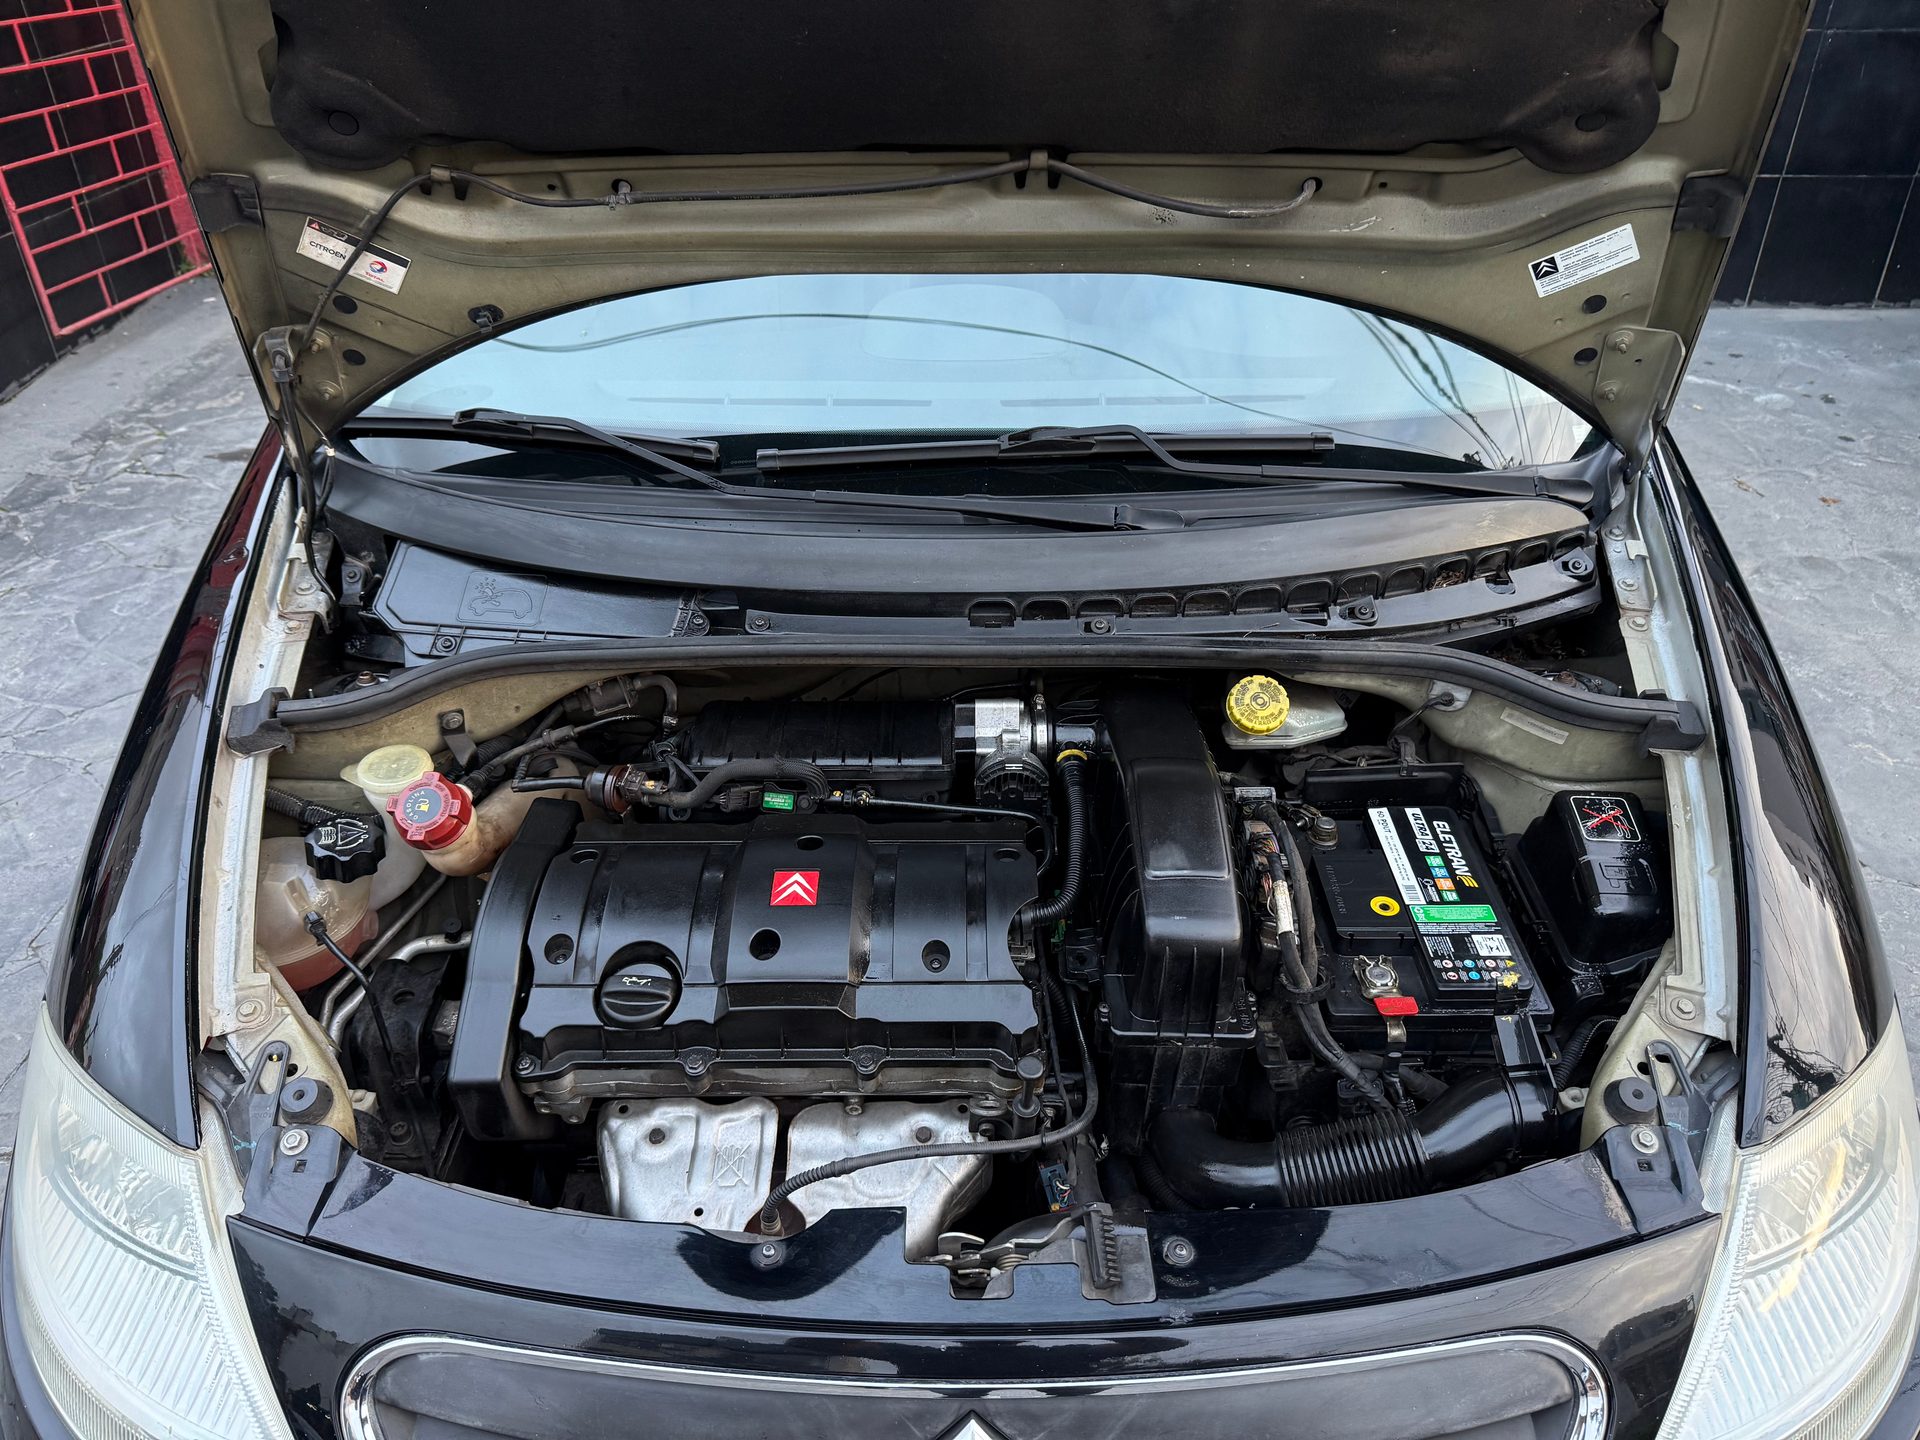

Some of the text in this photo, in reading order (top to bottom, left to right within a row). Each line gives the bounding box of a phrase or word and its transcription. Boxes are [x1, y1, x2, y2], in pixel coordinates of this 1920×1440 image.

[365, 272, 385, 282] TOTAL
[406, 790, 425, 820] GASOLINA
[1411, 812, 1429, 837] ULTRA
[1421, 840, 1435, 851] 24
[1433, 820, 1472, 877] ELETRAN
